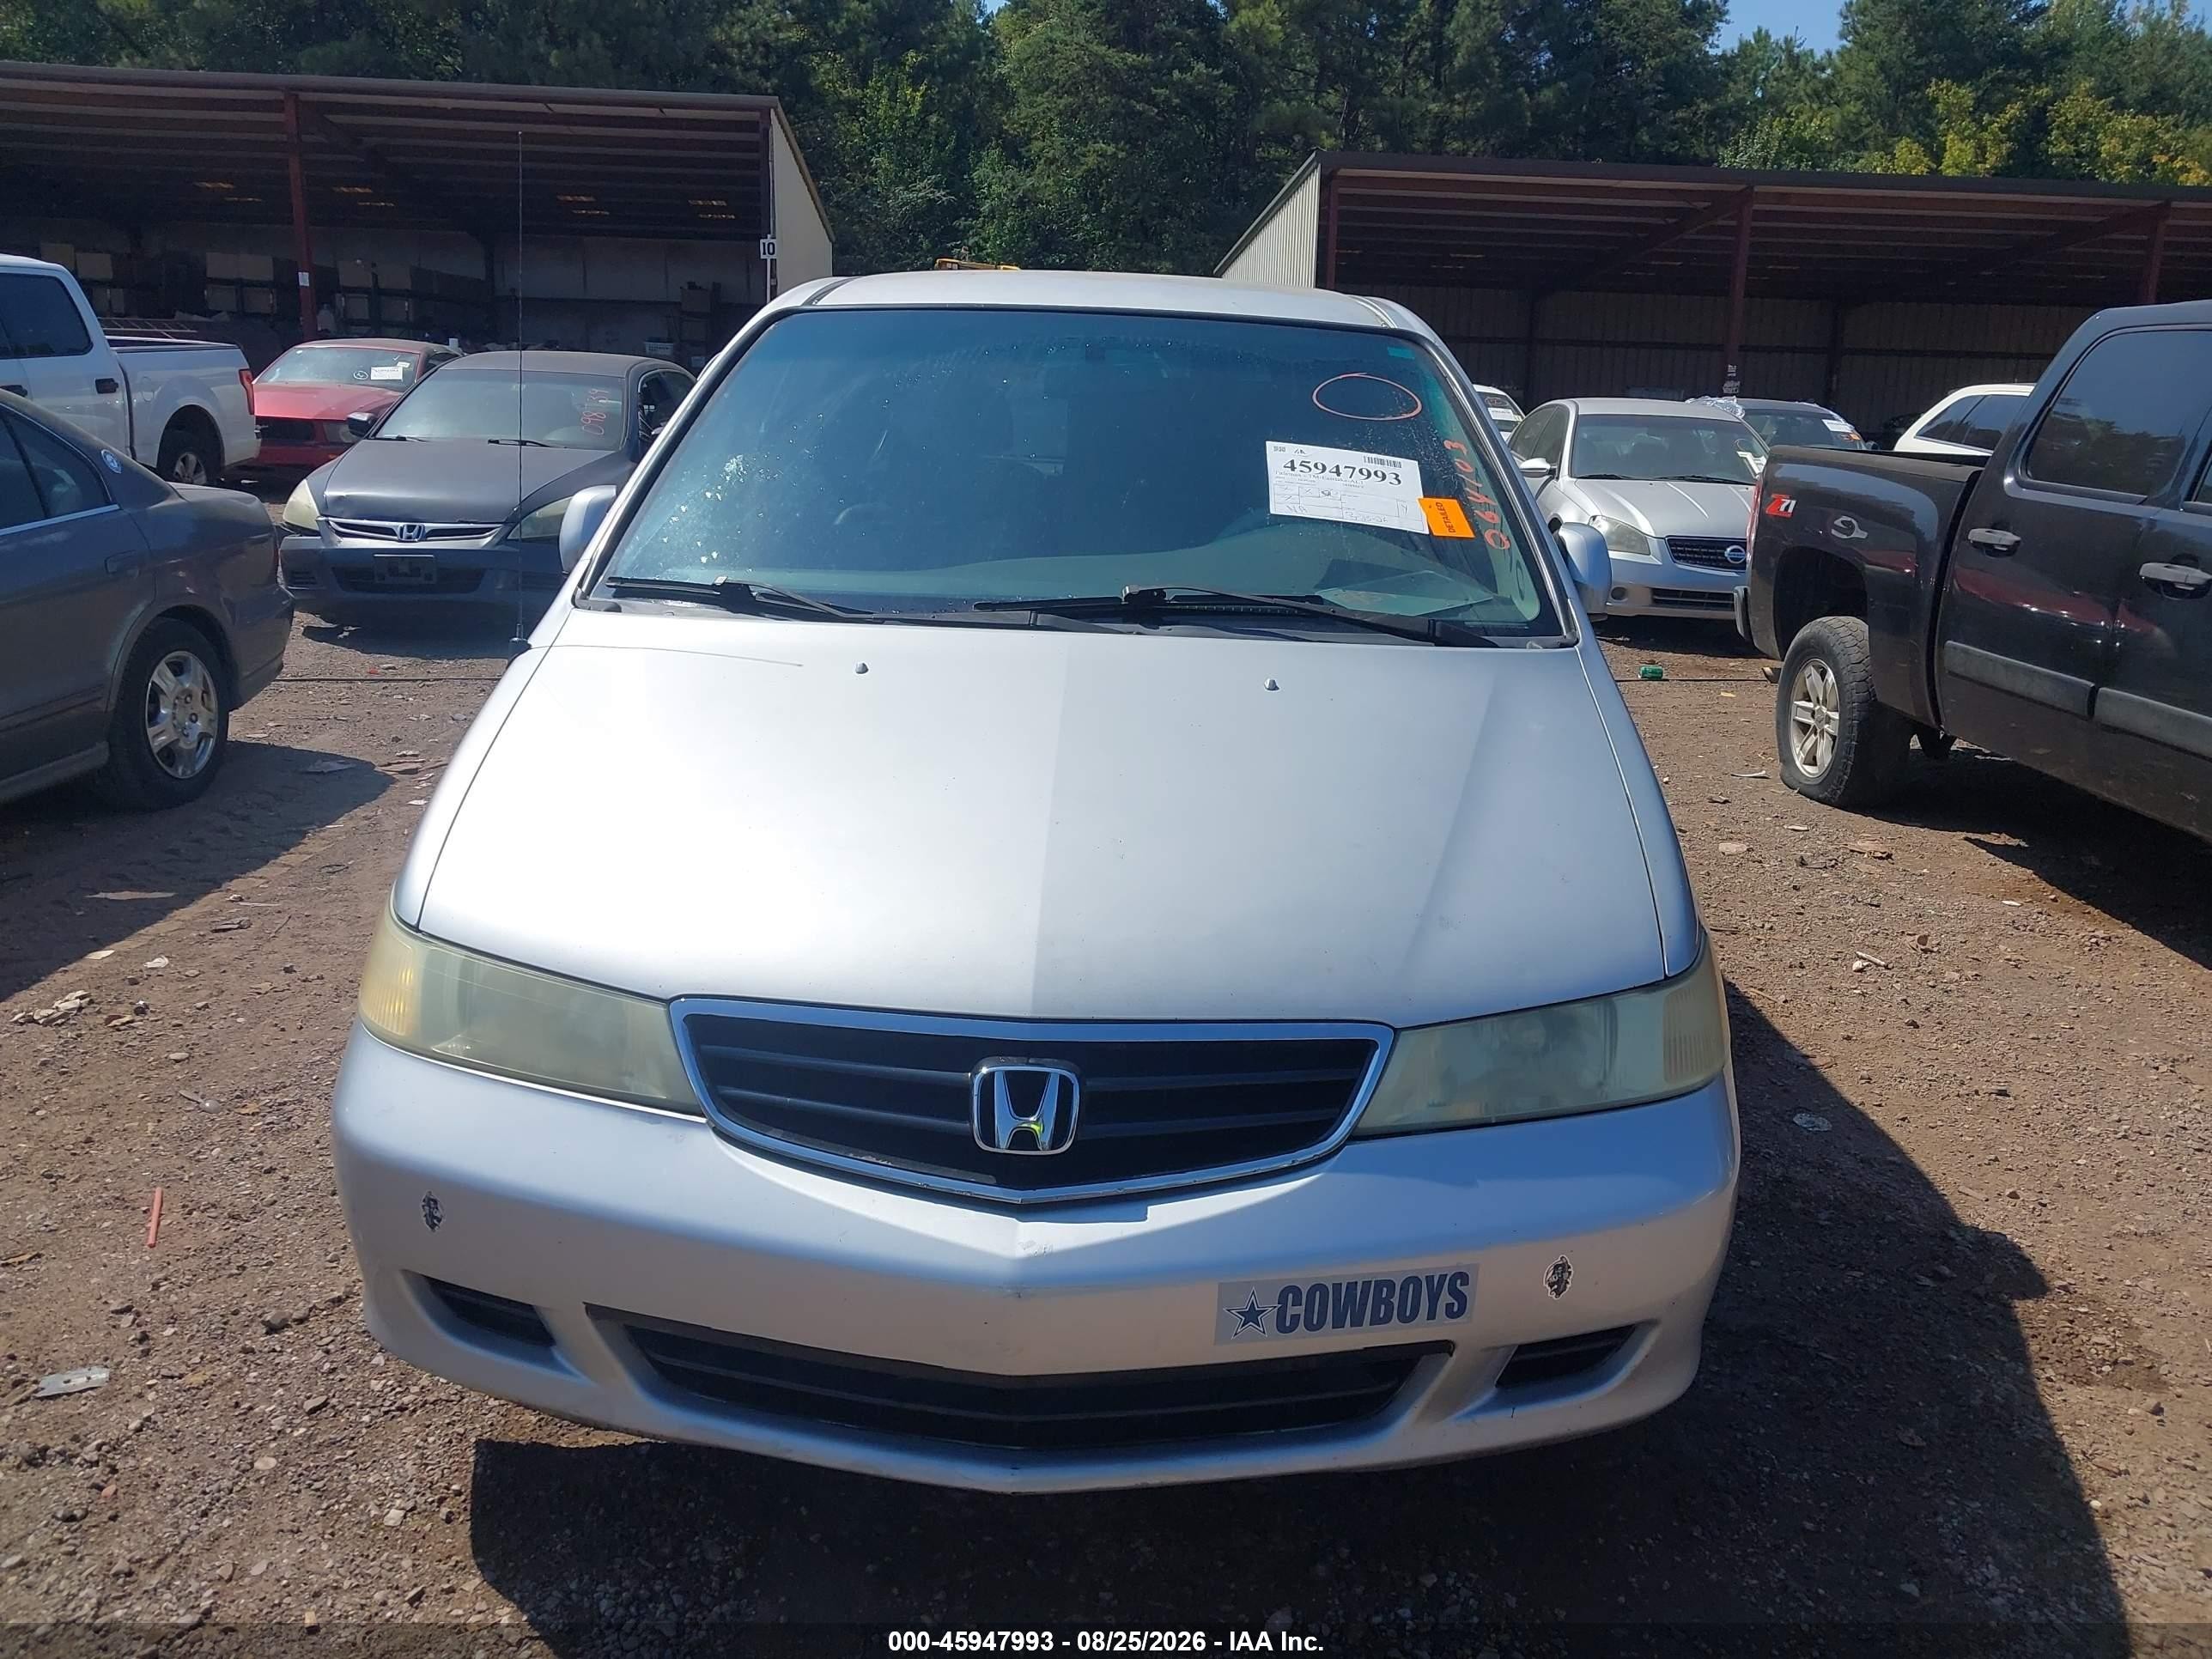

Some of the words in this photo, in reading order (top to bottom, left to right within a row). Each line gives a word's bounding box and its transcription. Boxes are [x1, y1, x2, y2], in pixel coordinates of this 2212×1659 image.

[762, 241, 775, 256] 10
[1283, 459, 1403, 486] 45947993
[1435, 501, 1457, 533] DETAILED
[1765, 493, 1797, 518] Z71
[1275, 1271, 1471, 1335] COWBOYS
